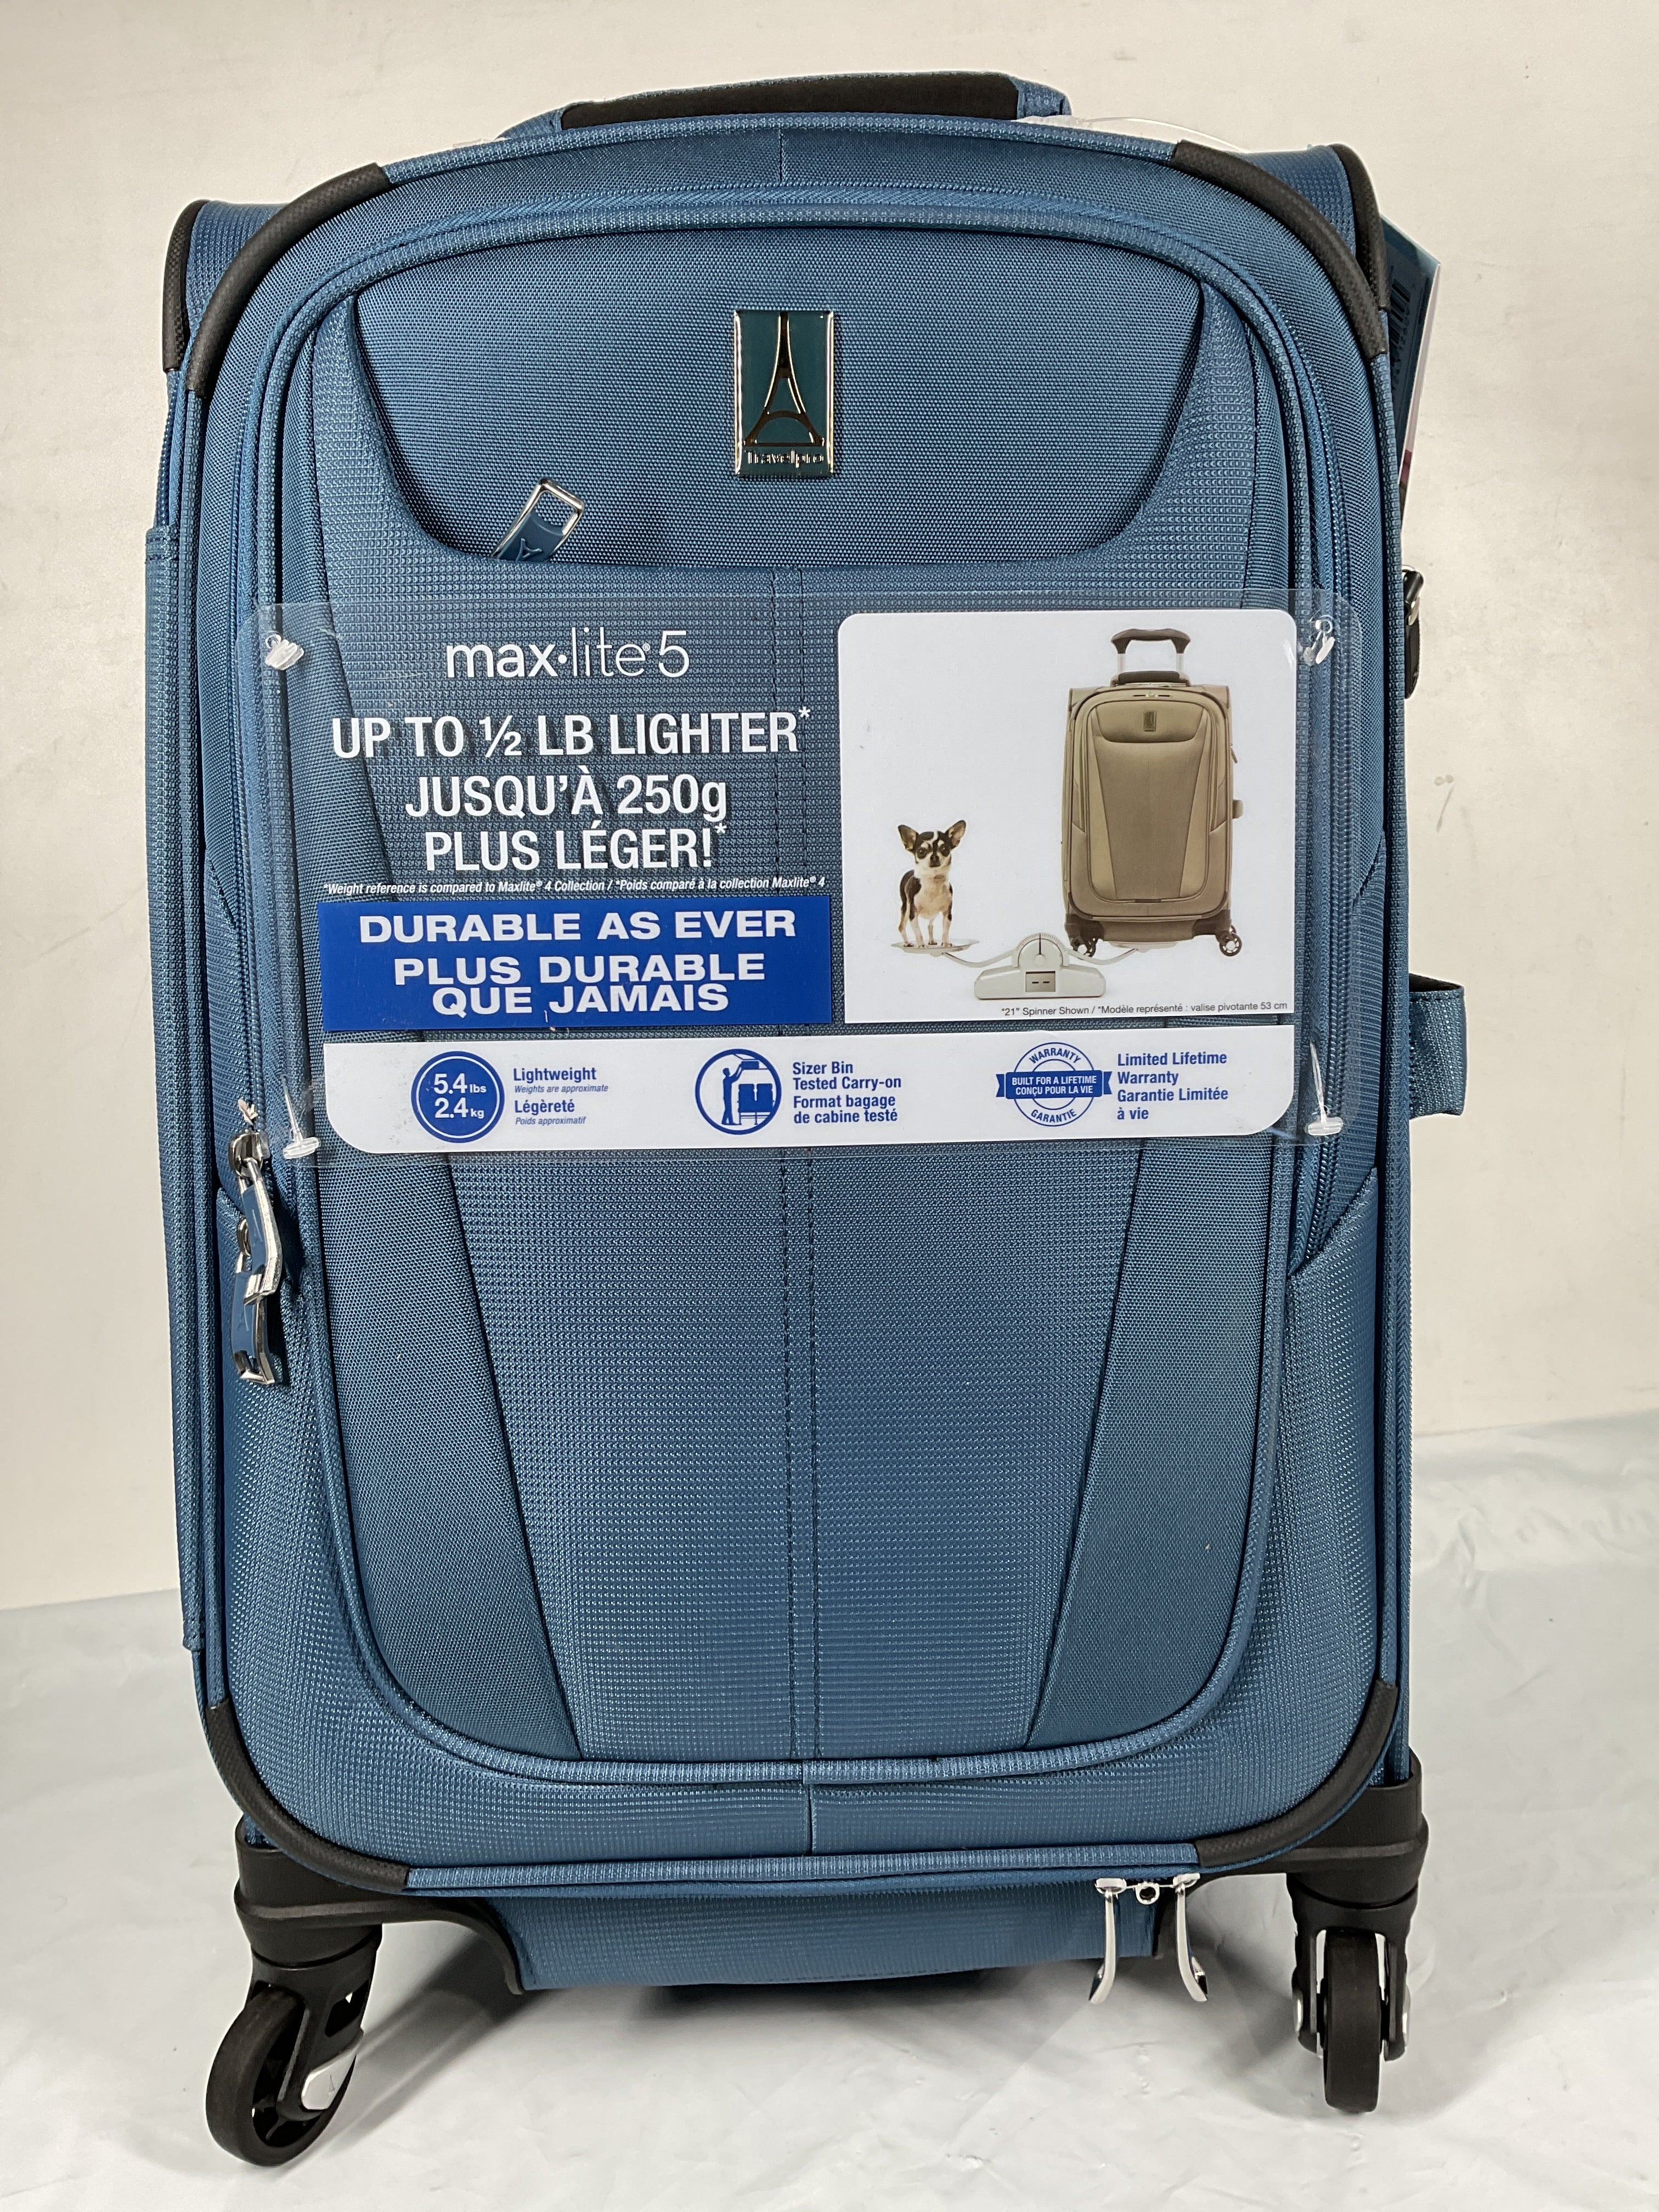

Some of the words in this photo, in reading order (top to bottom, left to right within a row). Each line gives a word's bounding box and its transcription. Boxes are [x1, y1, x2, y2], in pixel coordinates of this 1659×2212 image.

[658, 630, 689, 678] 5
[332, 718, 390, 758] UP
[406, 716, 464, 757] TO
[538, 714, 594, 755] LB
[616, 772, 726, 821] 250g
[425, 829, 539, 872] PLUS
[366, 883, 416, 895] reference
[418, 883, 427, 894] is
[431, 882, 483, 896] compared
[485, 882, 496, 893] to
[544, 881, 551, 891] 4
[554, 879, 605, 891] Collection
[651, 878, 696, 891] comparé
[698, 879, 705, 889] à
[707, 879, 716, 889] la
[719, 878, 769, 889] collection
[817, 877, 825, 888] 4
[360, 913, 581, 943] DURABLE
[598, 911, 661, 941] AS
[675, 910, 796, 939] EVER
[396, 956, 520, 985] PLUS
[541, 953, 765, 983] DURABLE
[433, 986, 532, 1018] QUE
[550, 983, 729, 1013] JAMAIS
[1022, 1006, 1056, 1017] Spinner
[1059, 1006, 1089, 1015] Shown
[1135, 1003, 1182, 1015] représenté
[1190, 1003, 1215, 1012] valise
[1217, 1002, 1259, 1014] pivotante
[1260, 1002, 1271, 1010] 53
[1029, 1048, 1081, 1064] WARRANTY
[1118, 1053, 1168, 1066] Limited
[1172, 1052, 1227, 1065] Lifetime
[514, 1067, 597, 1084] Lightweight
[792, 1062, 827, 1075] Sizer
[832, 1061, 853, 1074] Bin
[793, 1076, 837, 1090] Tested
[842, 1076, 901, 1091] Carry-on
[1012, 1076, 1034, 1086] BUILT
[1035, 1076, 1052, 1085] FOR
[1053, 1076, 1059, 1085] A
[1061, 1075, 1097, 1085] LIFETIME
[1118, 1071, 1179, 1085] Warranty
[514, 1085, 545, 1094] Weights
[561, 1084, 609, 1094] approximate
[1015, 1086, 1042, 1097] CONÇU
[1044, 1086, 1066, 1095] POUR
[1069, 1086, 1080, 1094] LA
[1080, 1085, 1093, 1094] VIE
[1118, 1088, 1174, 1102] Garantie
[1178, 1086, 1228, 1100] Limitée
[515, 1098, 575, 1115] Légèreté
[793, 1096, 842, 1108] Format
[846, 1094, 895, 1109] bagage
[516, 1116, 536, 1125] Poids
[538, 1116, 586, 1126] approximatif
[794, 1111, 810, 1124] de
[815, 1110, 860, 1123] cabine
[864, 1108, 898, 1121] testé
[1031, 1109, 1077, 1124] GARANTIE
[1117, 1107, 1125, 1120] à
[1130, 1107, 1149, 1120] vie
